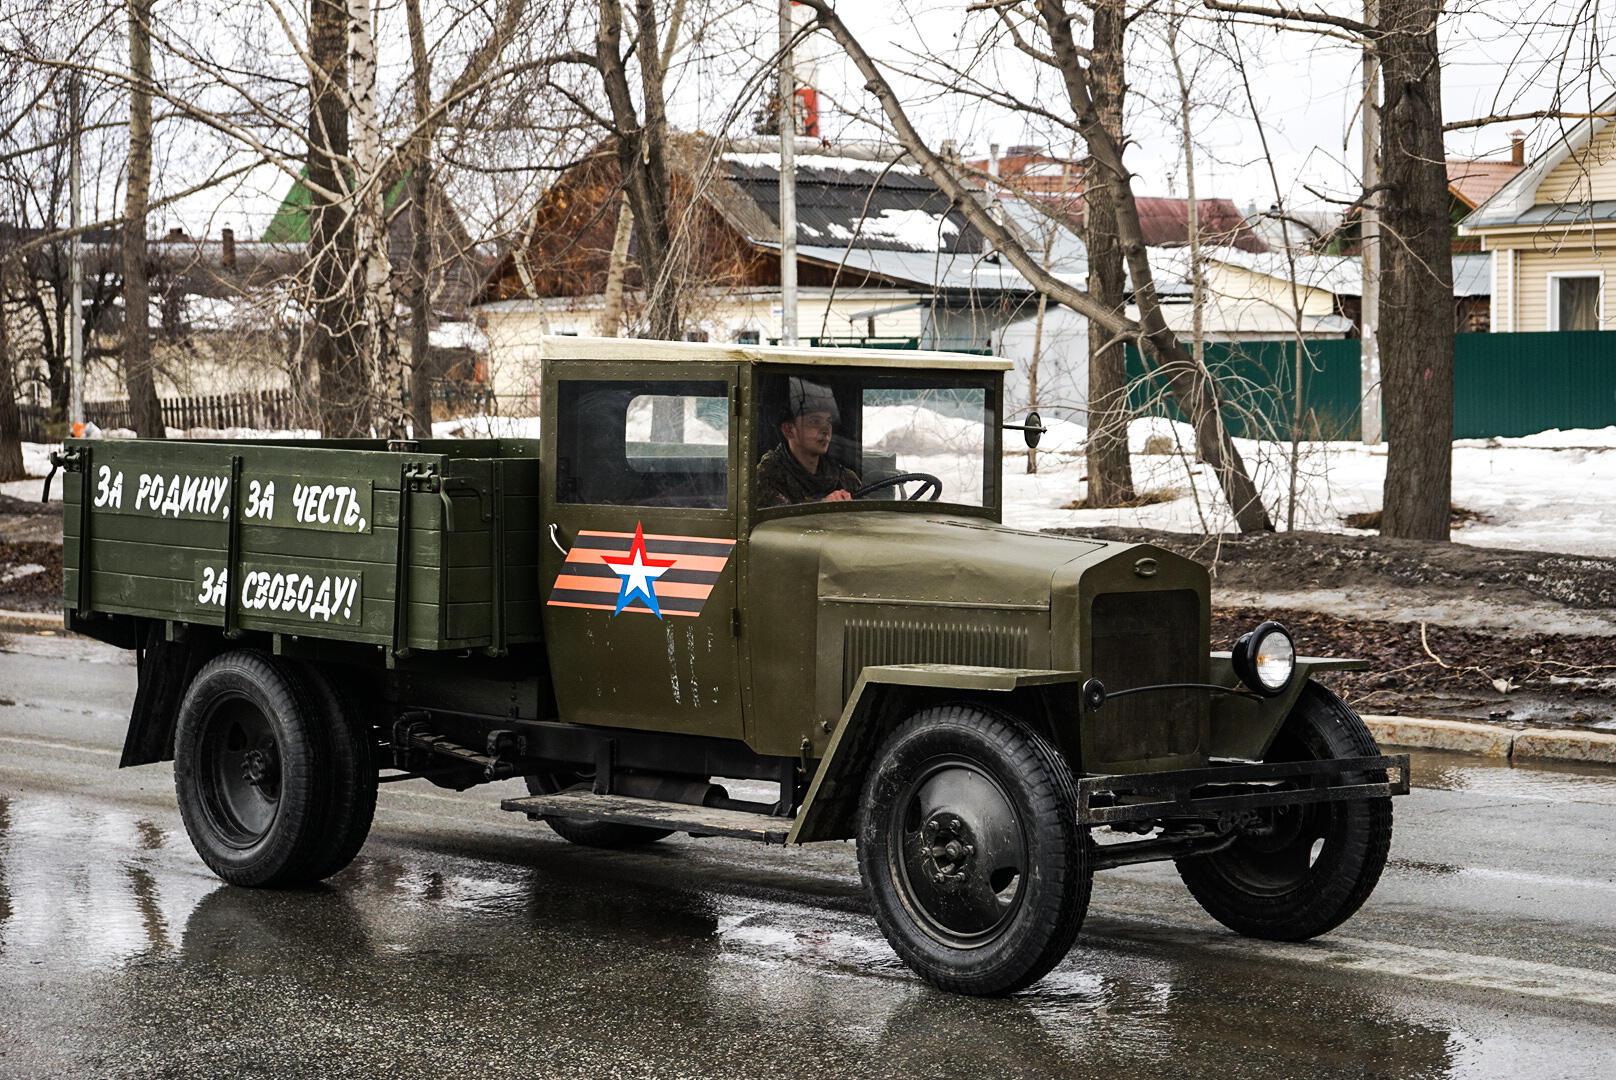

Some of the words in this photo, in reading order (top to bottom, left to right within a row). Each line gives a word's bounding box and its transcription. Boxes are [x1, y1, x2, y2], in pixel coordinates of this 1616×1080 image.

[93, 464, 124, 509] ЗА
[134, 473, 230, 520] РОДИНУ,
[244, 479, 275, 521] ЗА
[292, 483, 367, 532] ЧЕСТЬ,
[197, 566, 228, 607] ЗА
[241, 570, 358, 622] СВОБОДУ!
